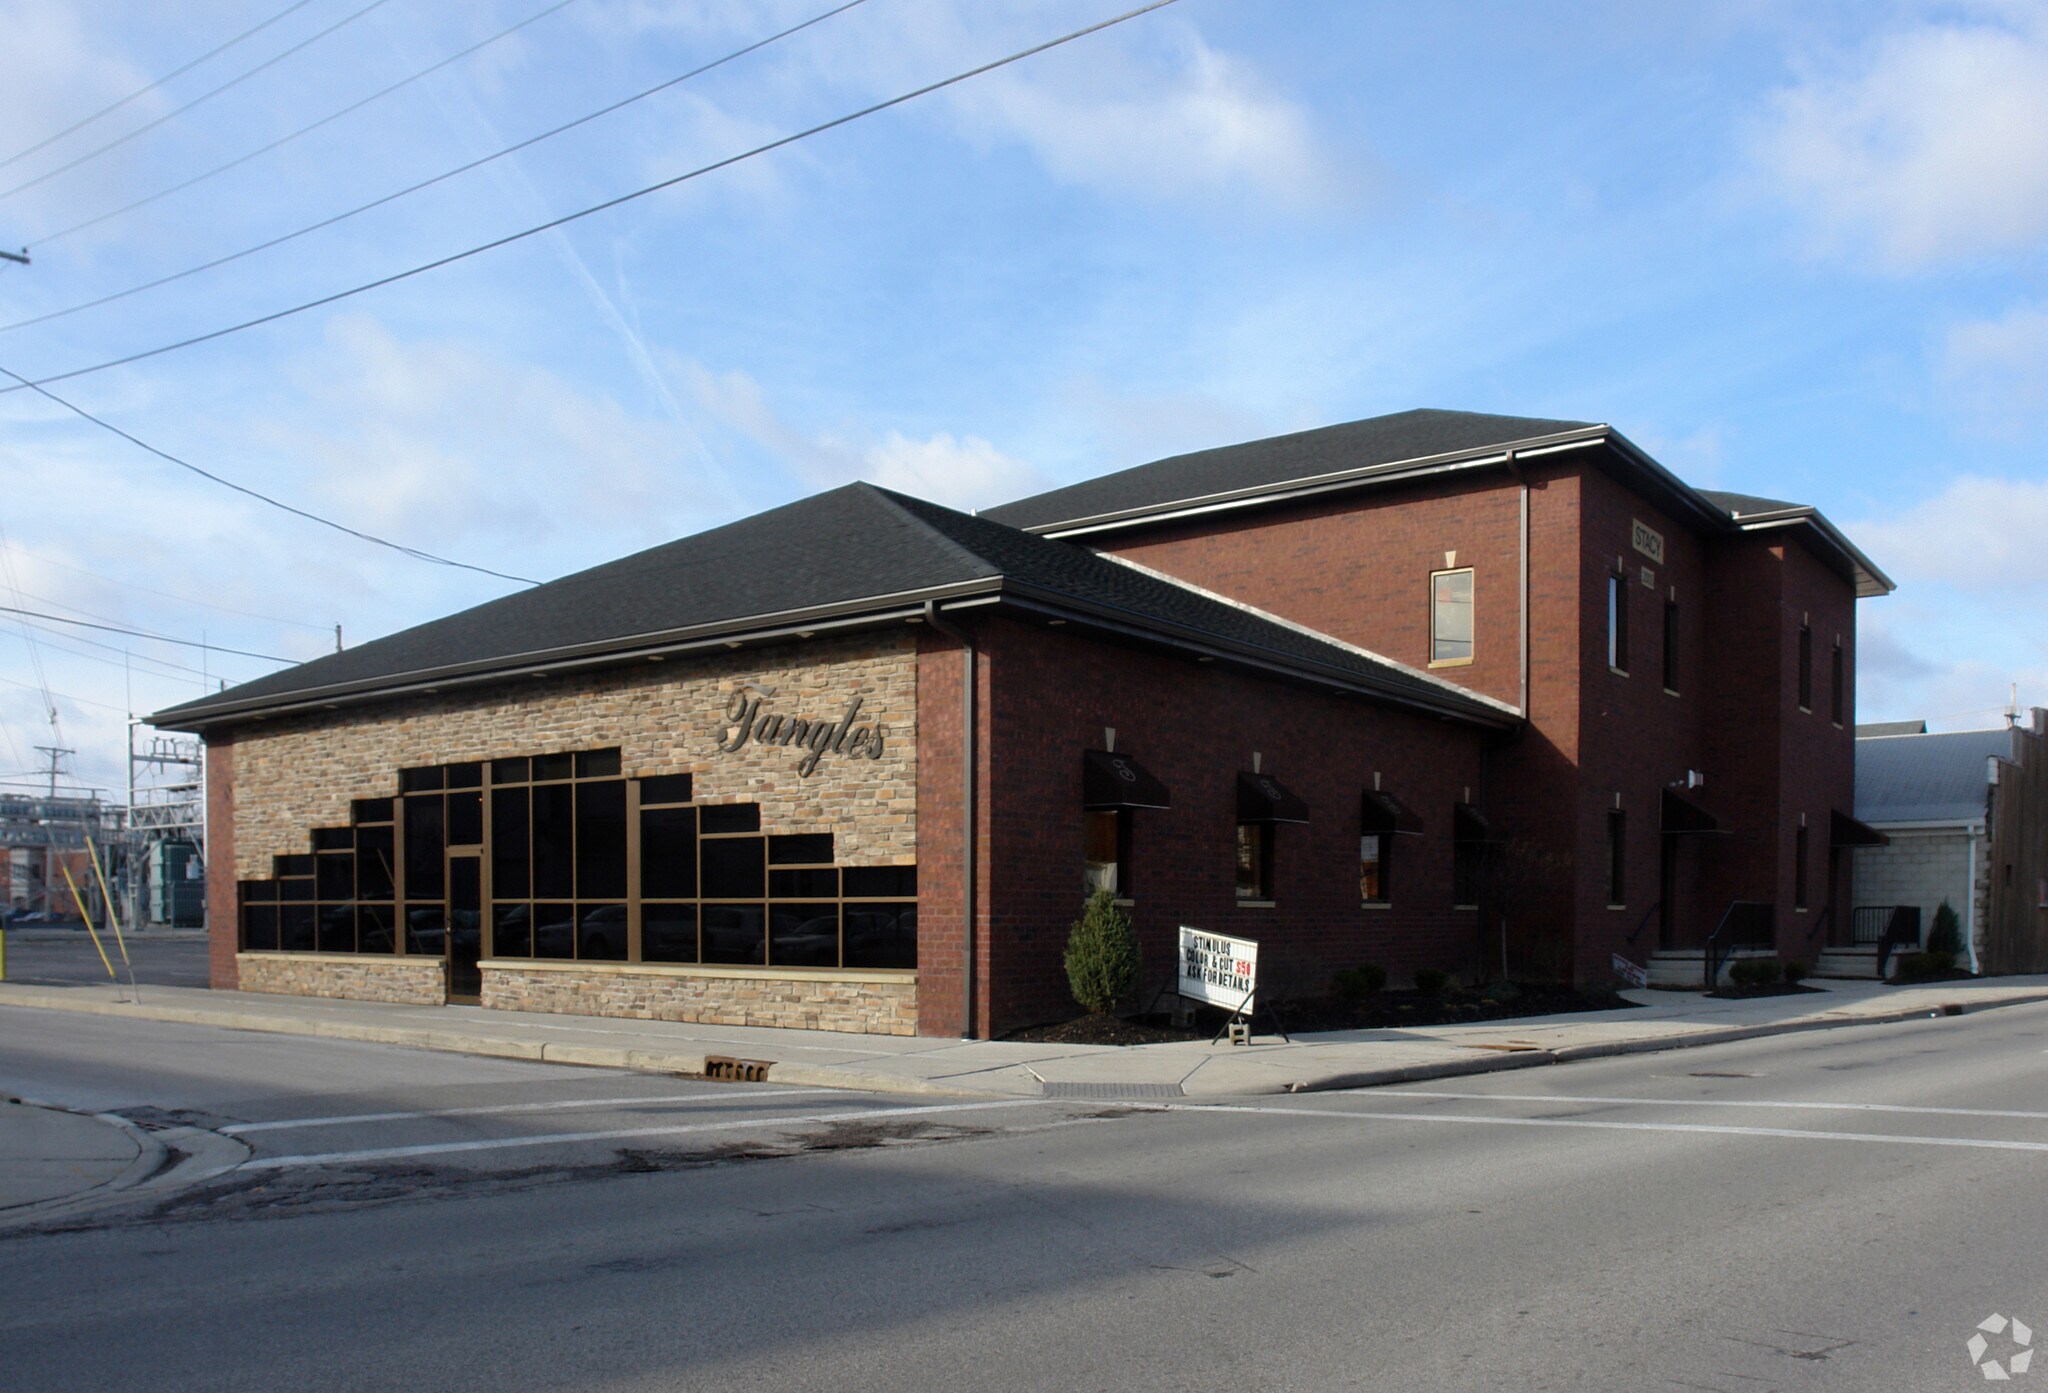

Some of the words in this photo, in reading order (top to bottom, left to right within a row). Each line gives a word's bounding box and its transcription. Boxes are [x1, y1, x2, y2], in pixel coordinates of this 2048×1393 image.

[717, 683, 883, 778] Tangles
[1193, 936, 1231, 956] STIMULUS
[1186, 949, 1208, 967] COLOR
[1219, 958, 1233, 972] CUT
[1187, 965, 1201, 980] ASK
[1203, 969, 1217, 984] FOR
[1218, 973, 1250, 993] DETAILS
